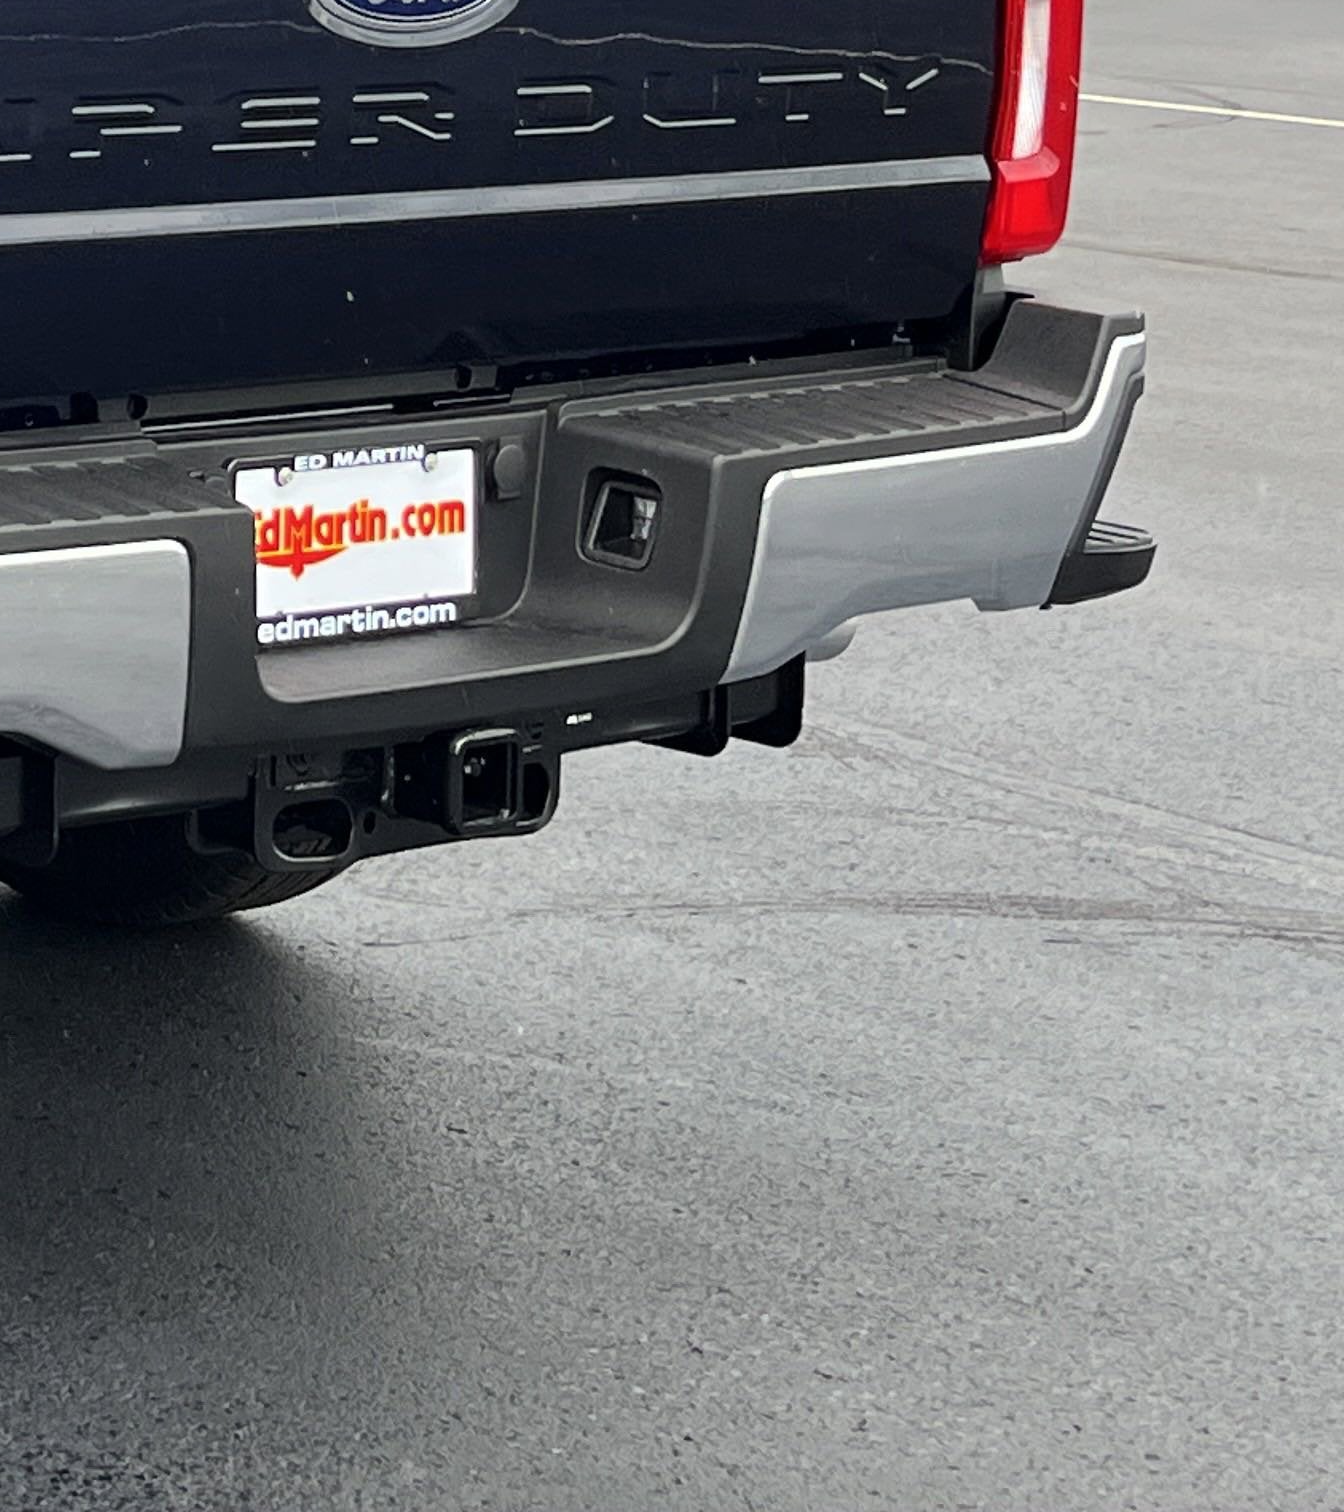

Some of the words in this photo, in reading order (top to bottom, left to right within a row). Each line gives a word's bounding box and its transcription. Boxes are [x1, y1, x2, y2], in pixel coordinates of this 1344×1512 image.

[514, 64, 940, 140] DUTY
[294, 454, 326, 472] ED
[332, 444, 425, 468] MARTIN
[257, 601, 457, 645] edmartin.com
